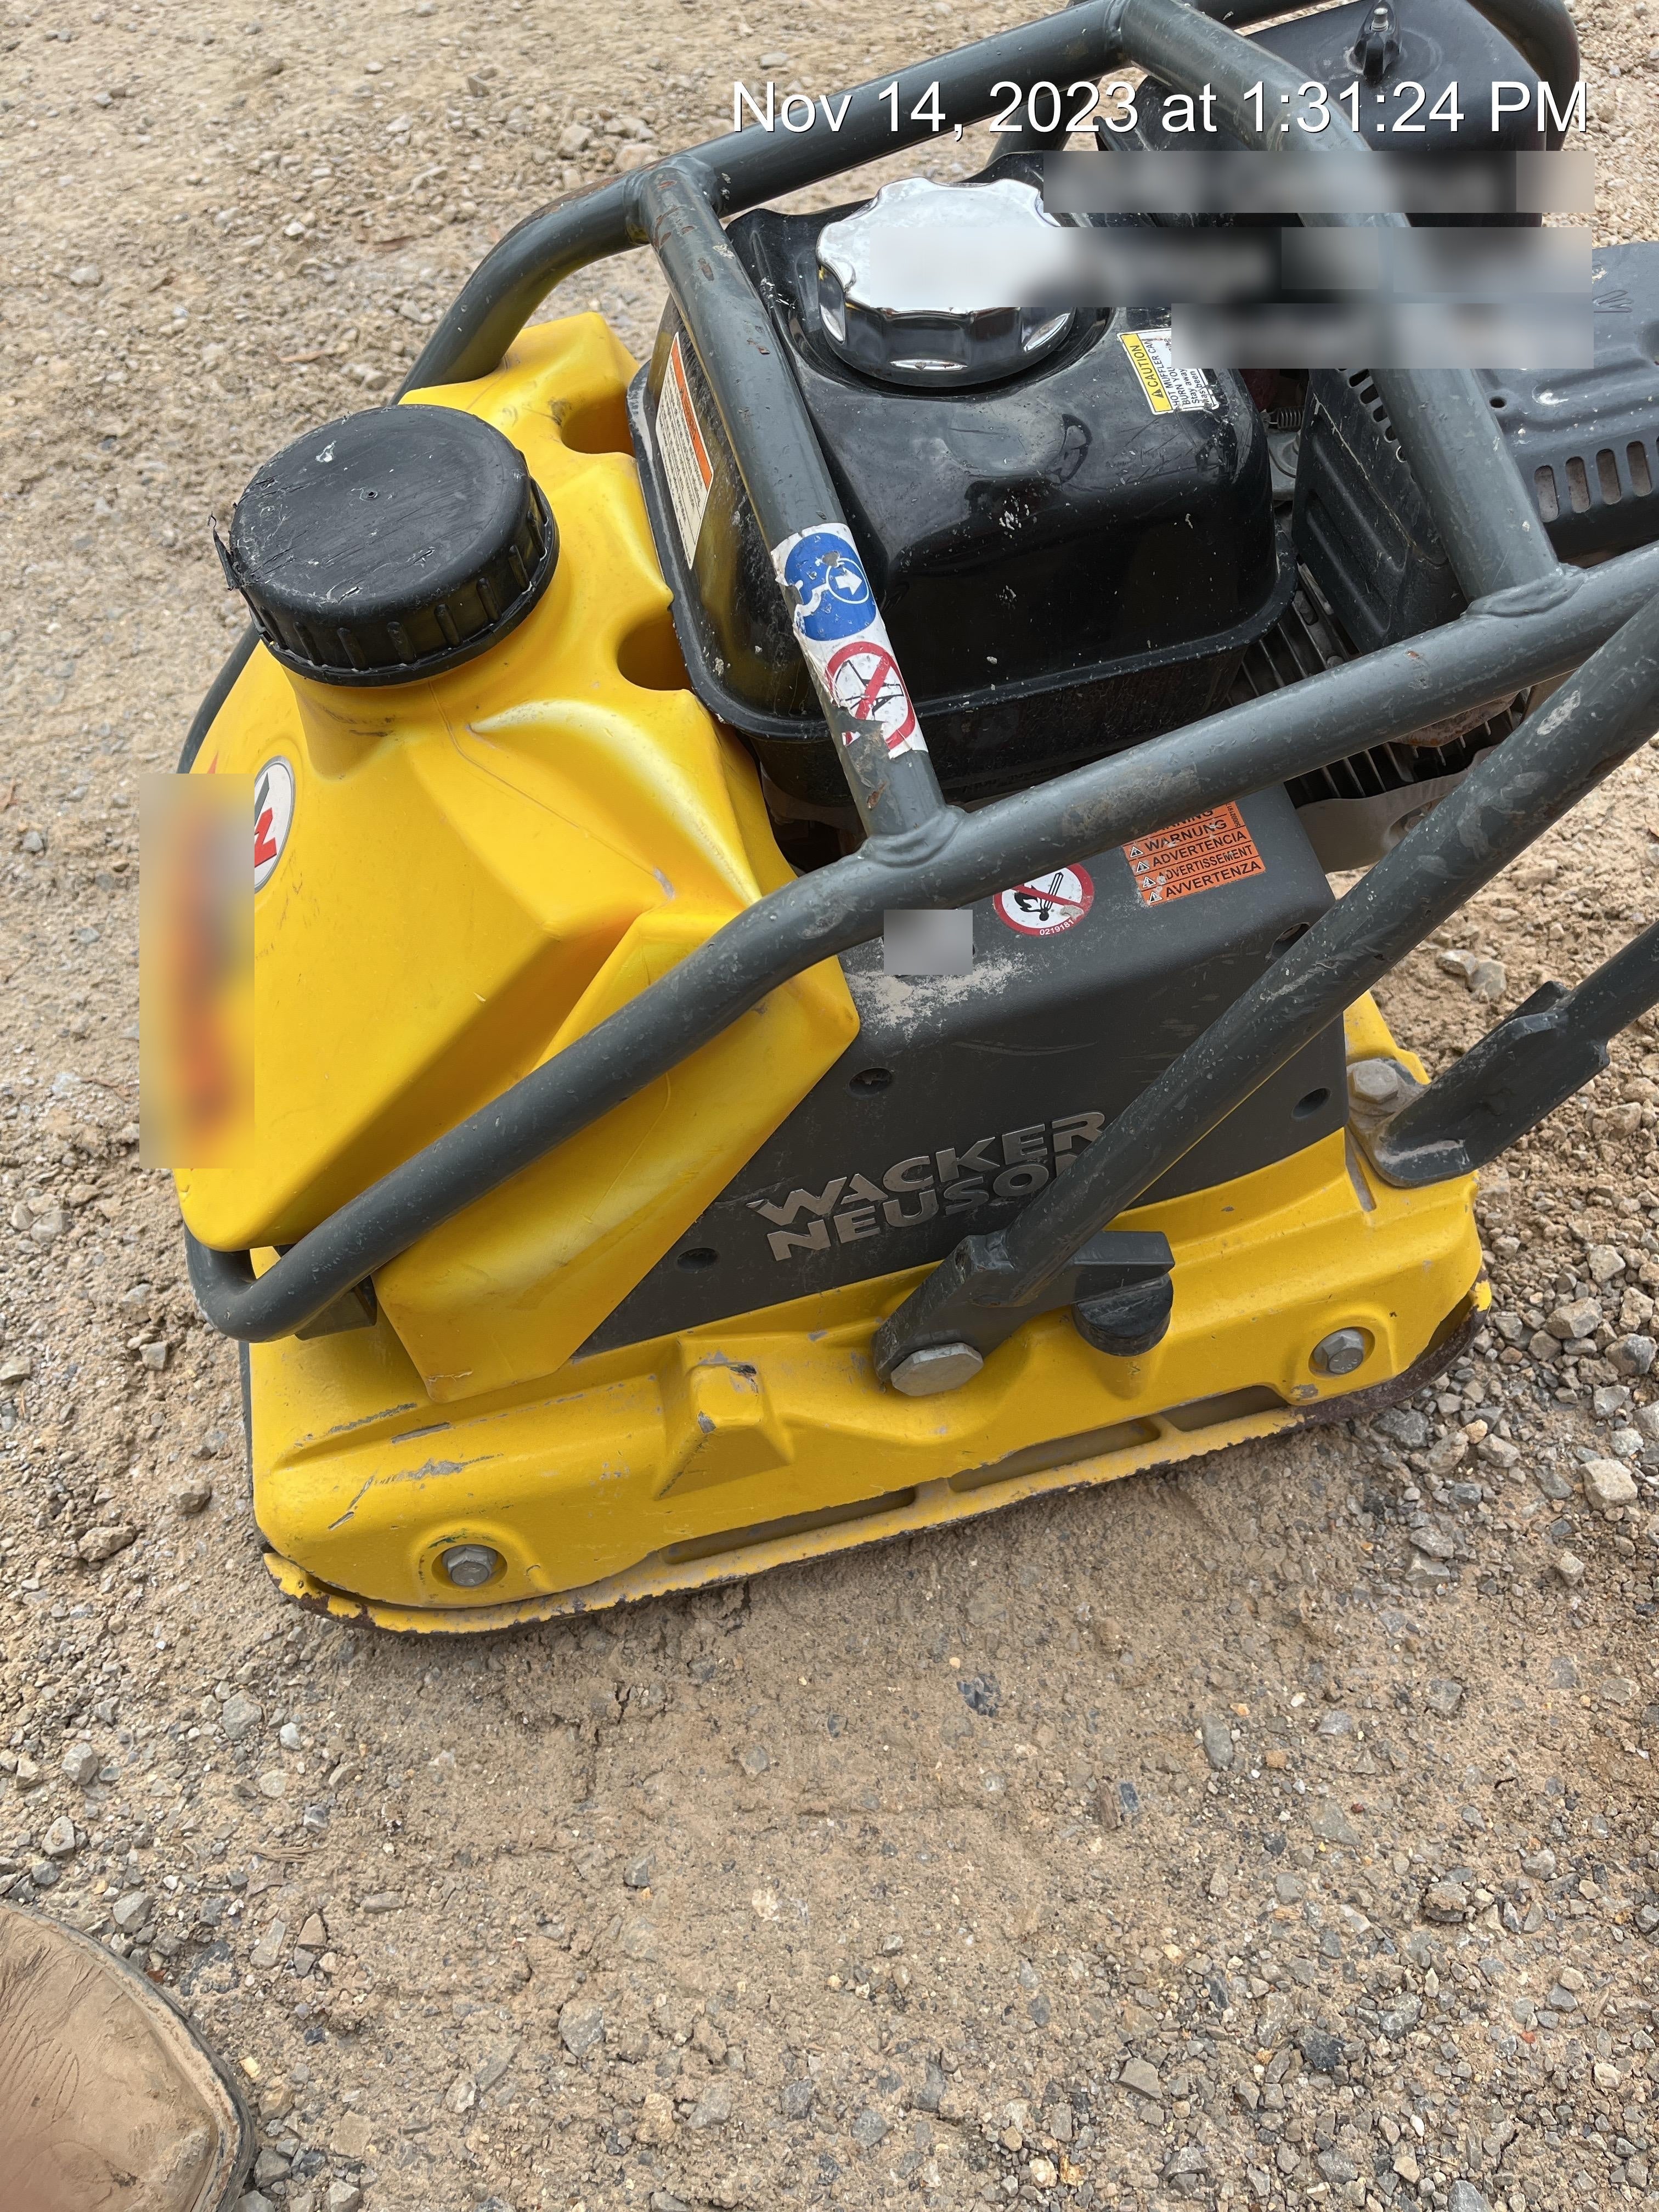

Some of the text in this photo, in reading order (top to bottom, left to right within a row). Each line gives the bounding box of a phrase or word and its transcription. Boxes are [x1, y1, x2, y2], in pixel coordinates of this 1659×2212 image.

[1130, 345, 1159, 387] CAUTION
[1152, 355, 1173, 388] MUFFLER
[1190, 371, 1203, 388] been
[1175, 384, 1191, 405] BURN
[1179, 368, 1200, 404] Stay away
[1144, 819, 1227, 851] WARNUNG
[1153, 831, 1246, 867] ADVERTENCIA
[1166, 861, 1262, 898] AVVERTENZA
[1039, 919, 1074, 935] 0219181
[745, 1110, 1105, 1227] WACKER
[767, 1153, 1080, 1261] NEUSO
